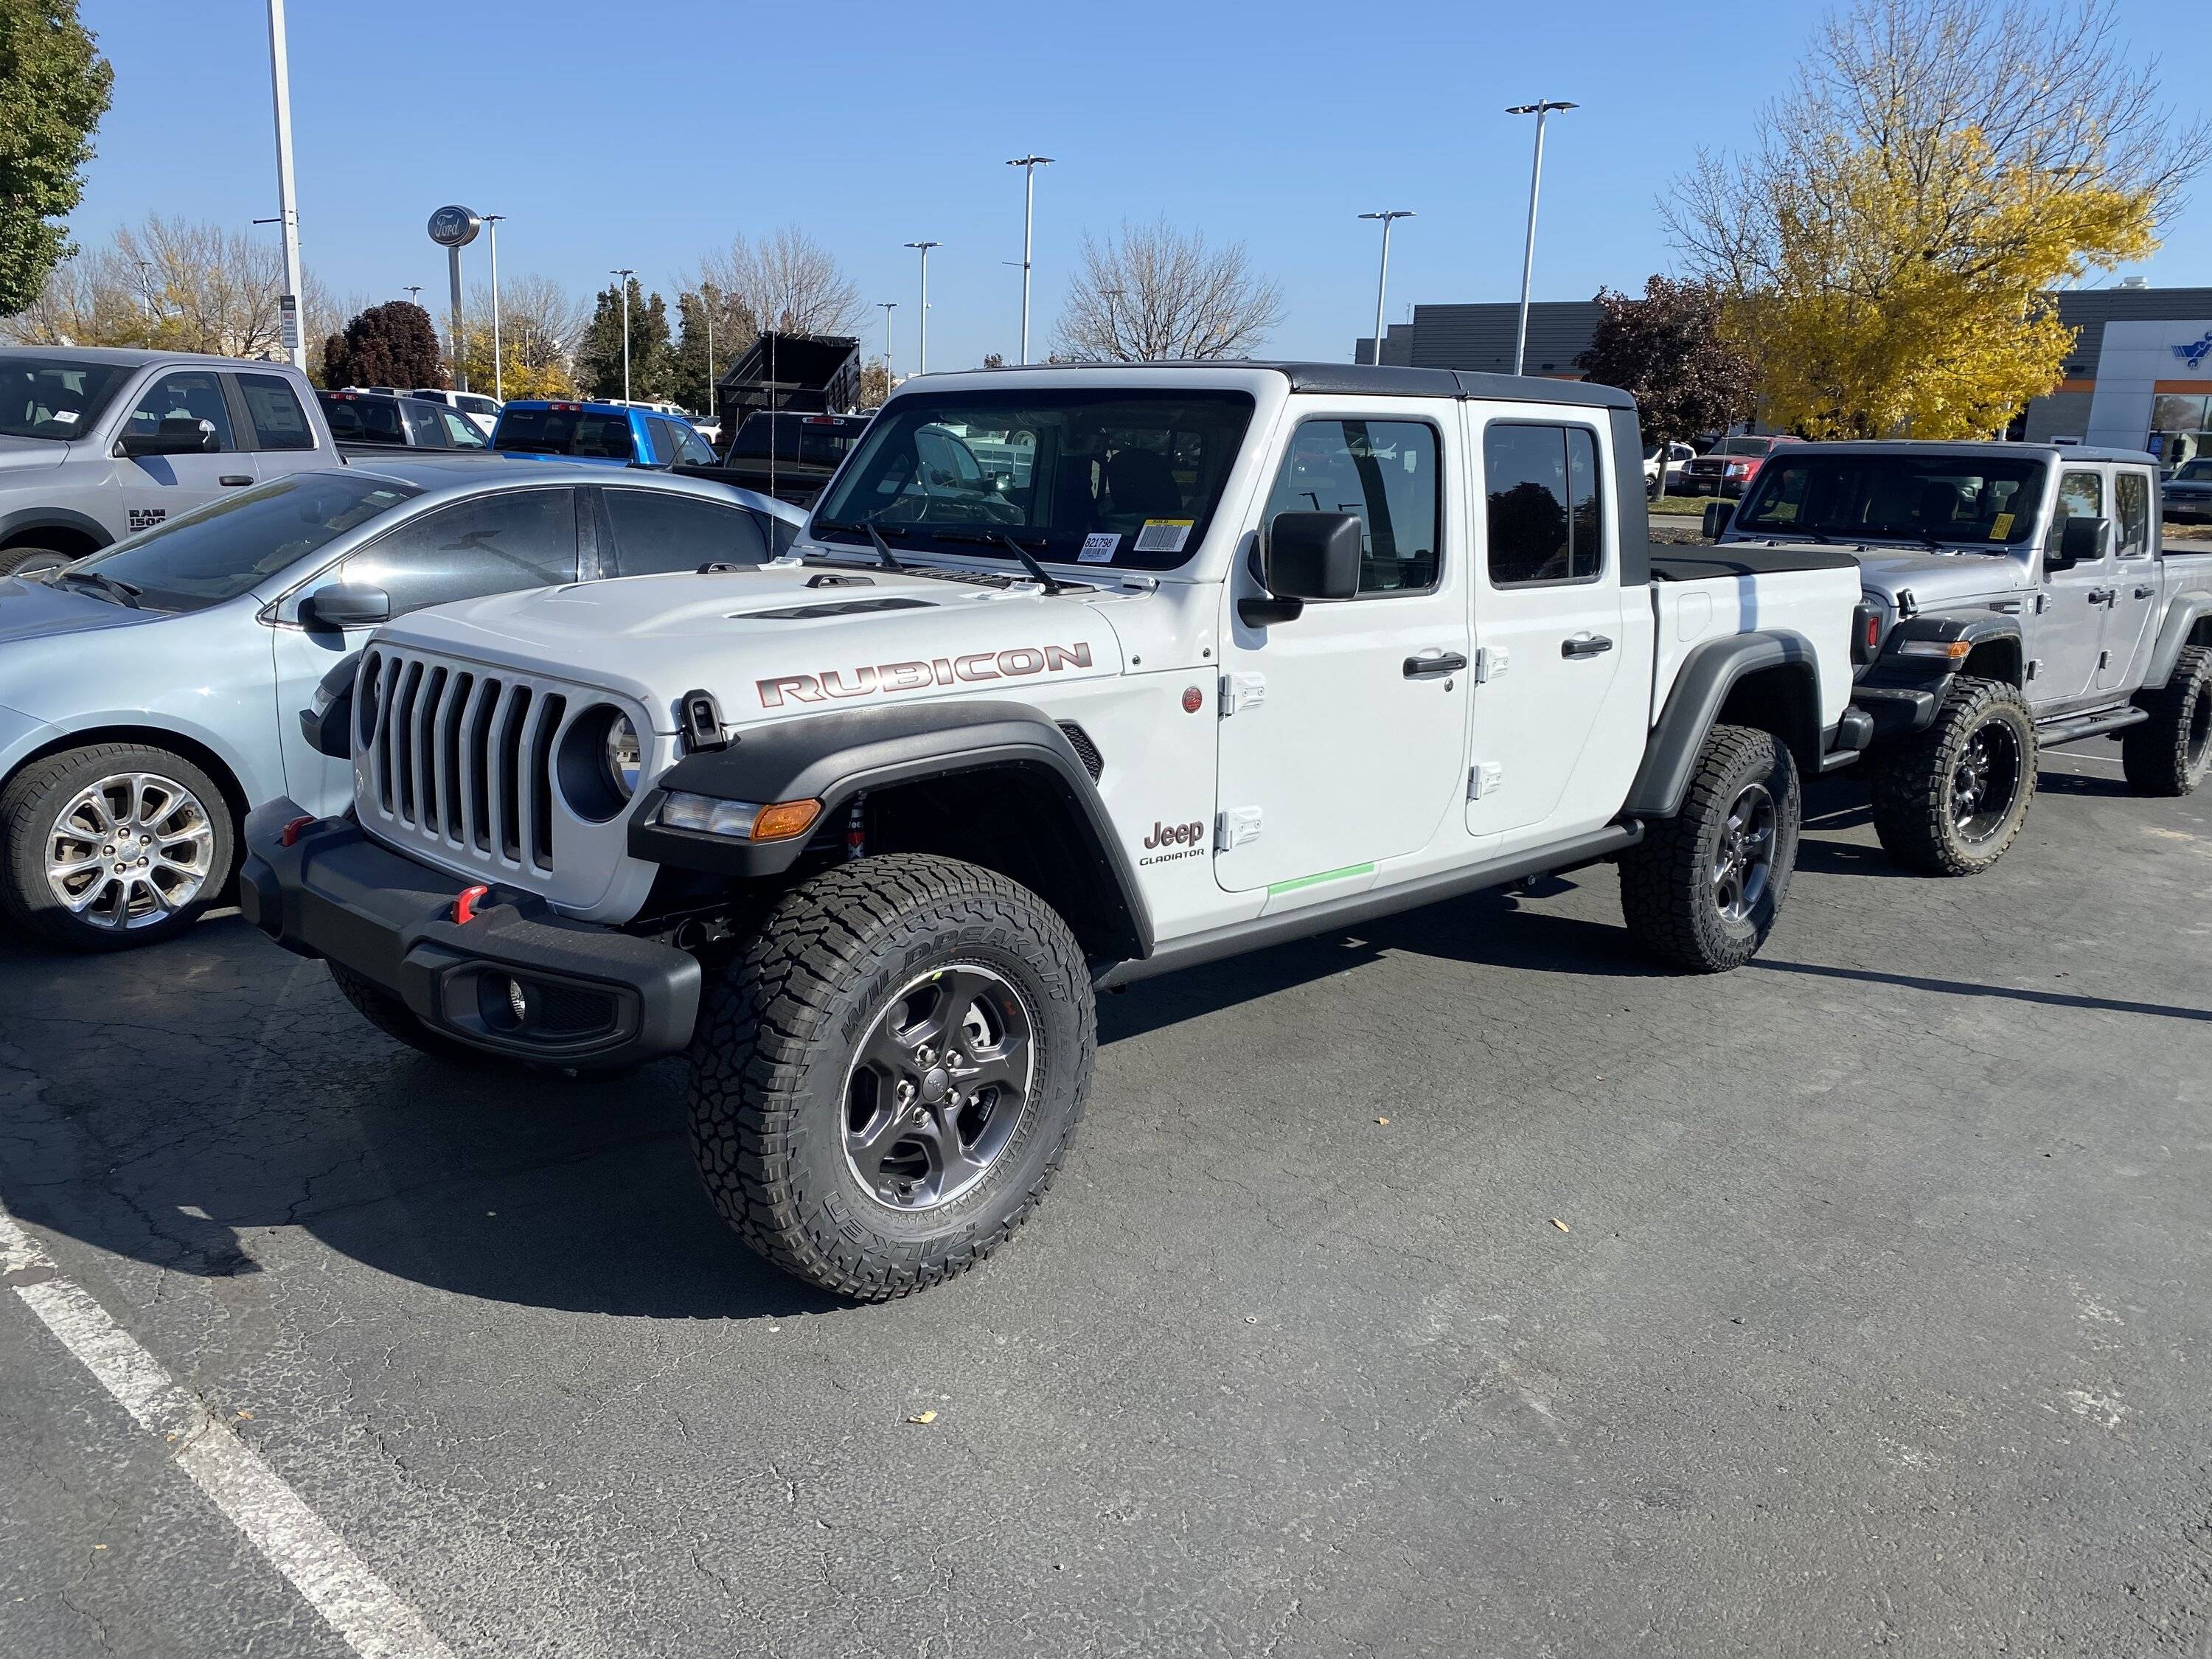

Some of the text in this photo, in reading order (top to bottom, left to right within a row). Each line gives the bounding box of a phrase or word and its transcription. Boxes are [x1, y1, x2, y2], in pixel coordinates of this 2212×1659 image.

[435, 214, 460, 237] Ford
[128, 509, 166, 518] RAM
[1085, 538, 1113, 548] 821798
[755, 642, 1093, 708] RUBICON
[1144, 821, 1205, 849] Jeep
[1139, 848, 1205, 866] GLADIATOR
[841, 925, 1031, 1044] WILDPEAK
